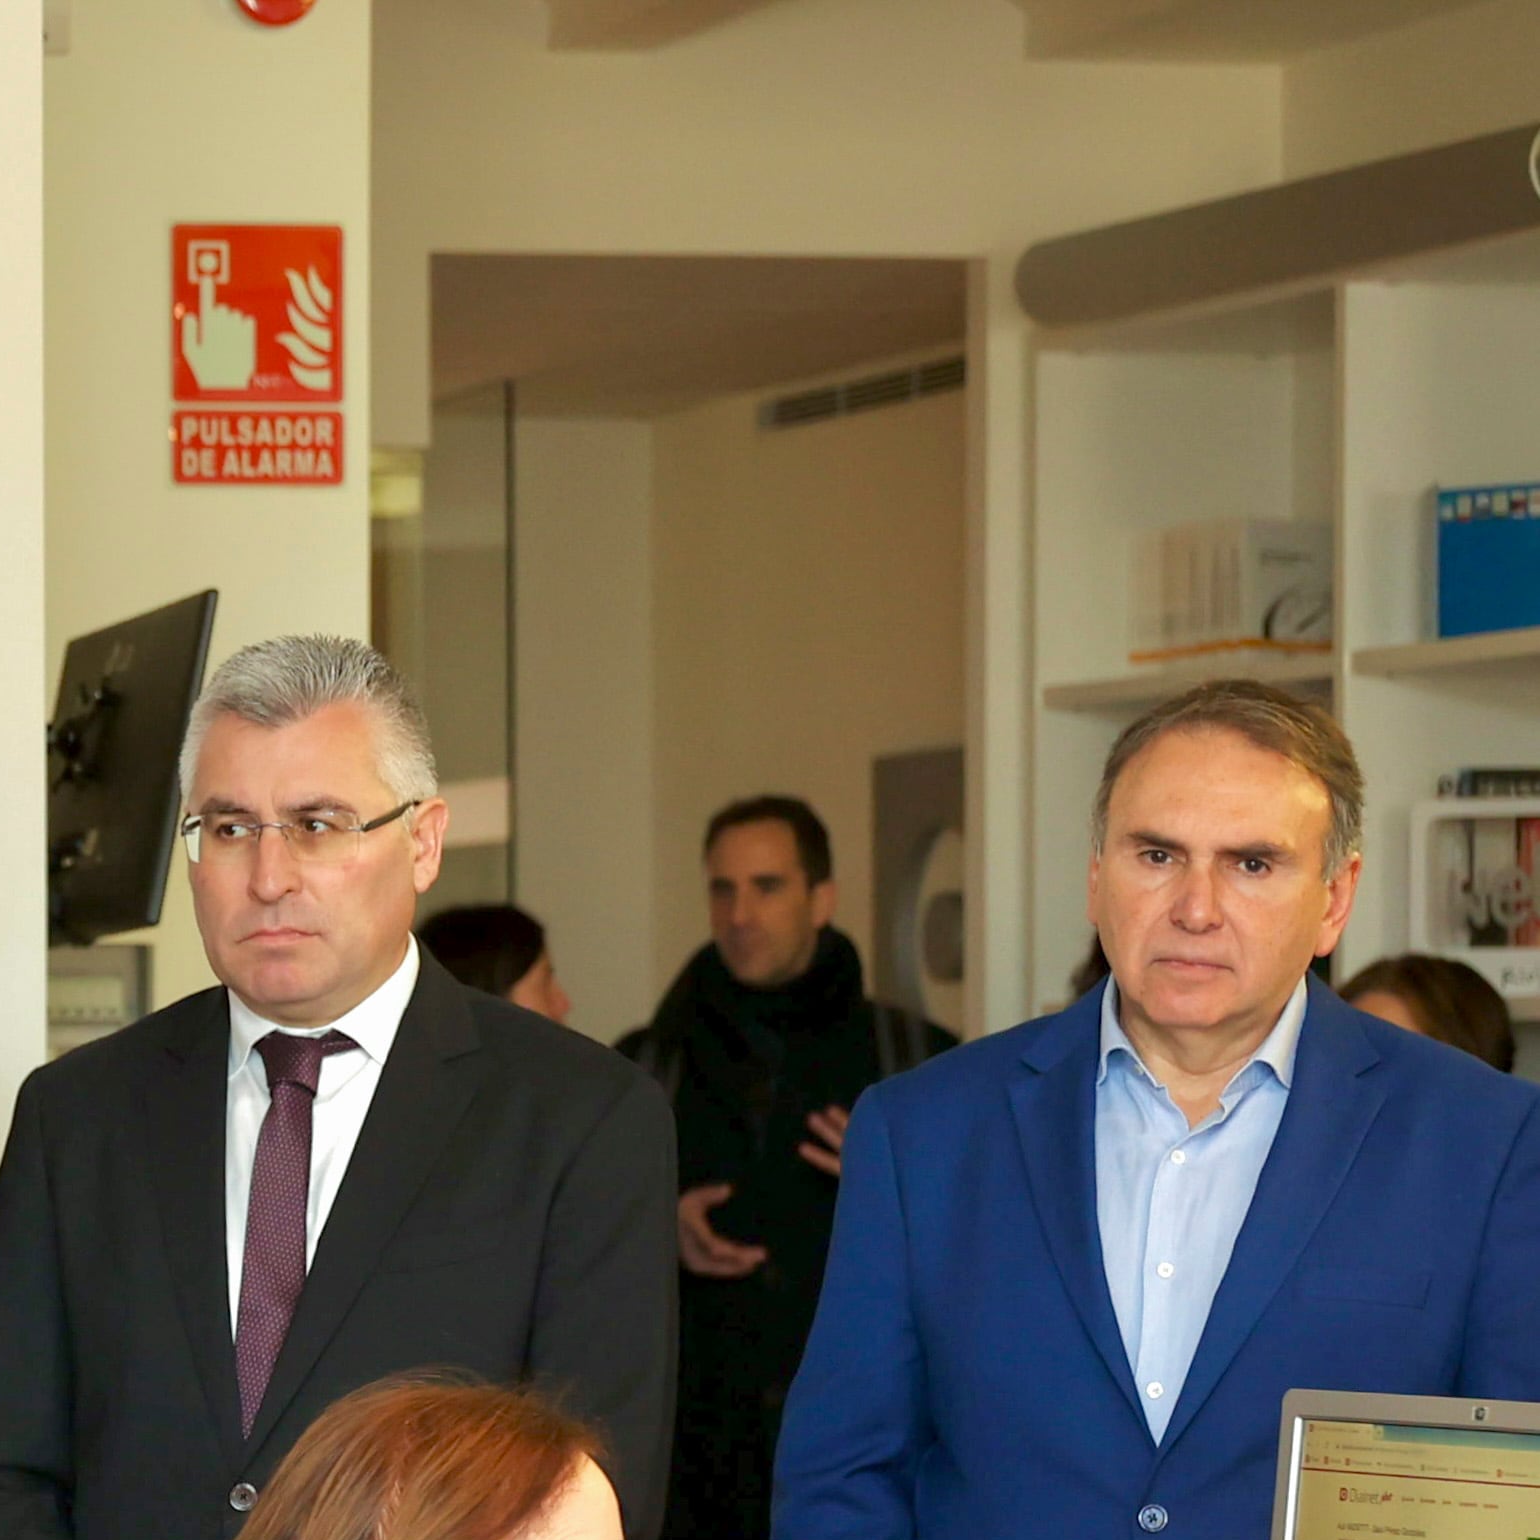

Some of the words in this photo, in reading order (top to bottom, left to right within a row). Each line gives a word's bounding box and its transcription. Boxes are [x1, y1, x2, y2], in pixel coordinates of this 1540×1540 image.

[181, 417, 334, 447] PULSADOR
[181, 448, 216, 478] DE
[222, 448, 335, 478] ALARMA
